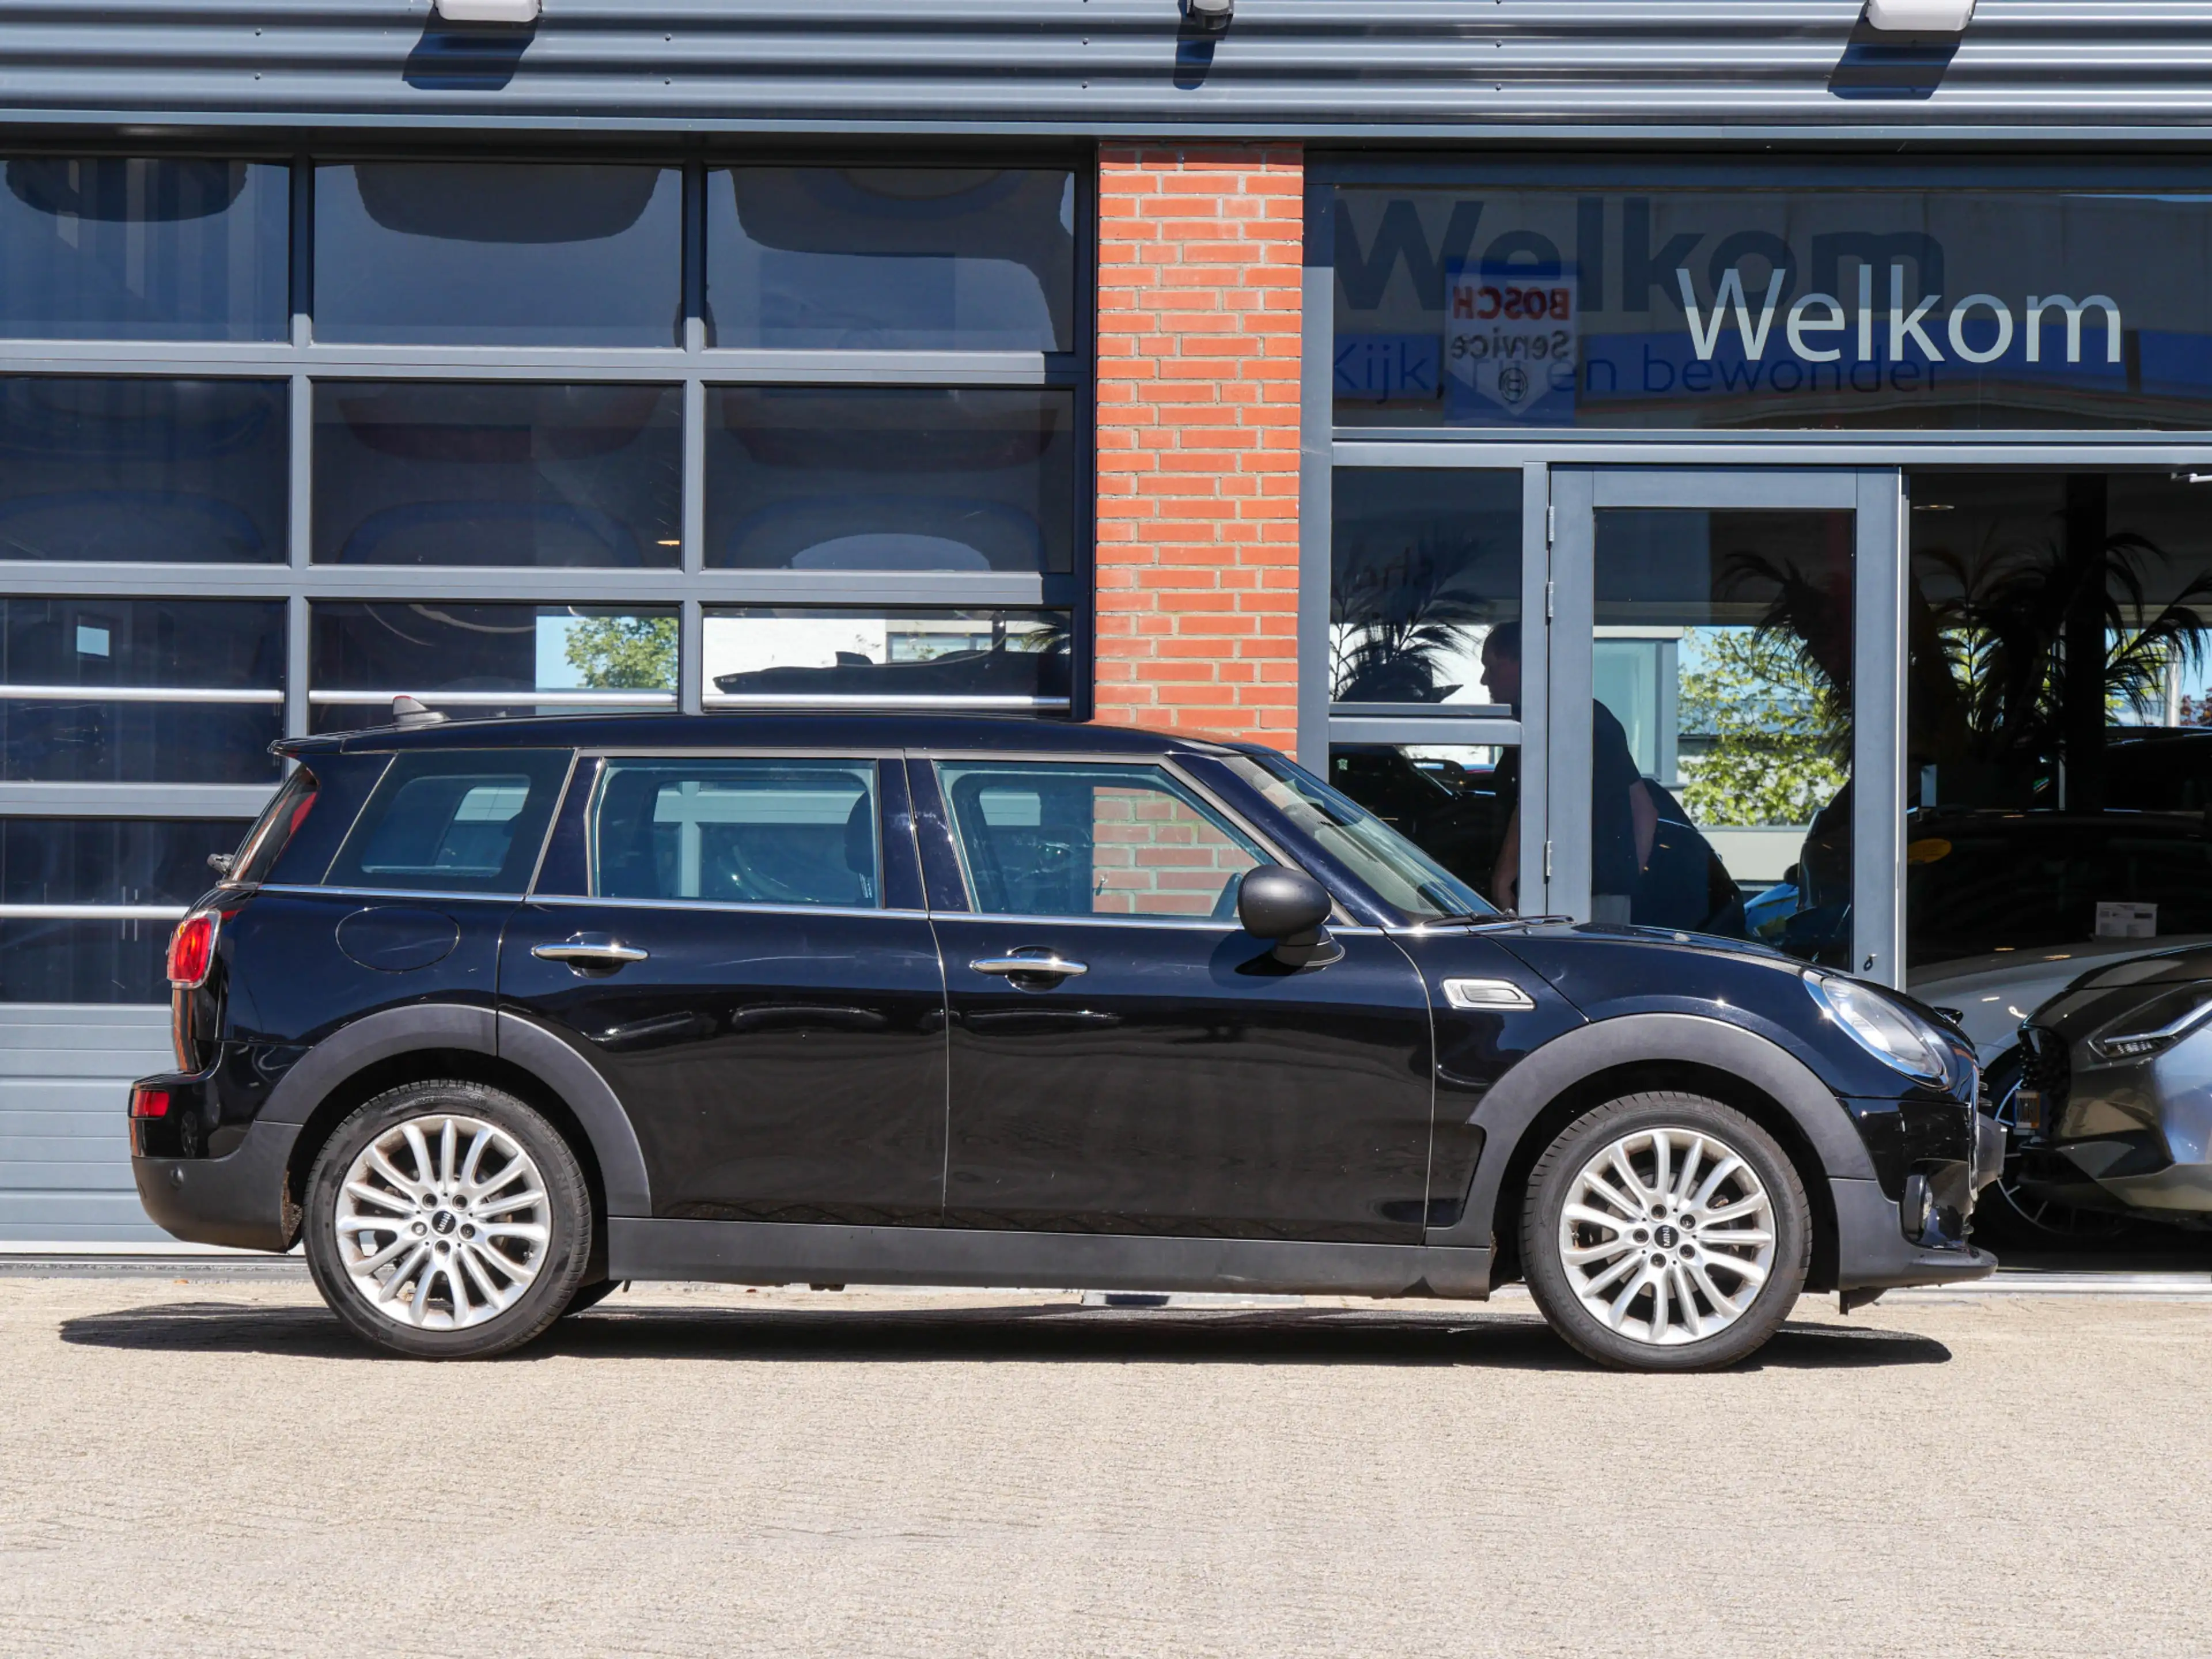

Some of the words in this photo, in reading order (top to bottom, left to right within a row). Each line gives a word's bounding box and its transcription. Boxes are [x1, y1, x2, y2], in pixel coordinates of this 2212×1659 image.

[1334, 196, 1945, 312] Welkom
[1676, 264, 2121, 363] Welkom
[1547, 358, 1617, 393] en
[1643, 343, 1944, 393] bewonder
[437, 1213, 451, 1233] MINI
